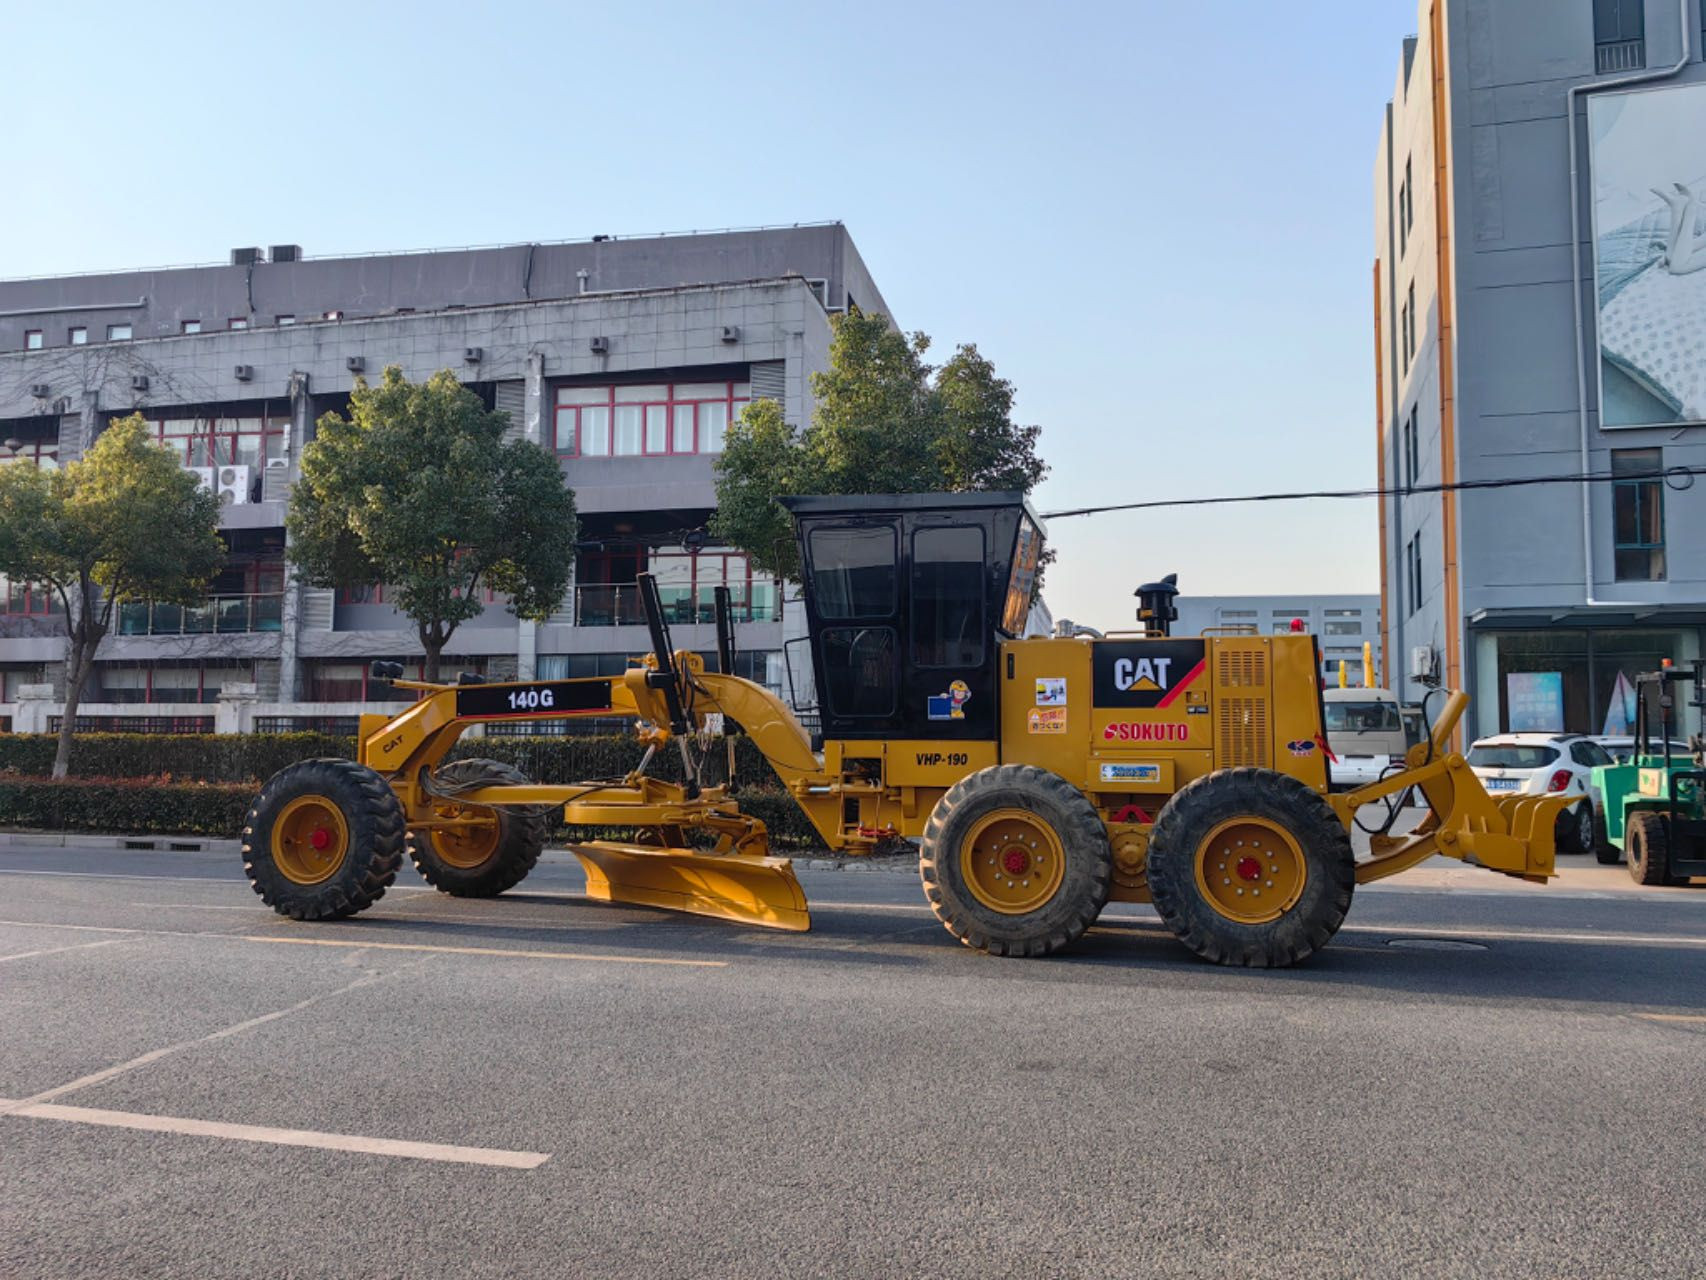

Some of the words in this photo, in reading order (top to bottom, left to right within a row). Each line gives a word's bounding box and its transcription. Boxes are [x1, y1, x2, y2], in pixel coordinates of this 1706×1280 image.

[1115, 657, 1171, 691] CAT
[1119, 723, 1188, 741] SOKUTO
[382, 735, 404, 753] CAT
[916, 753, 968, 766] VHP-190
